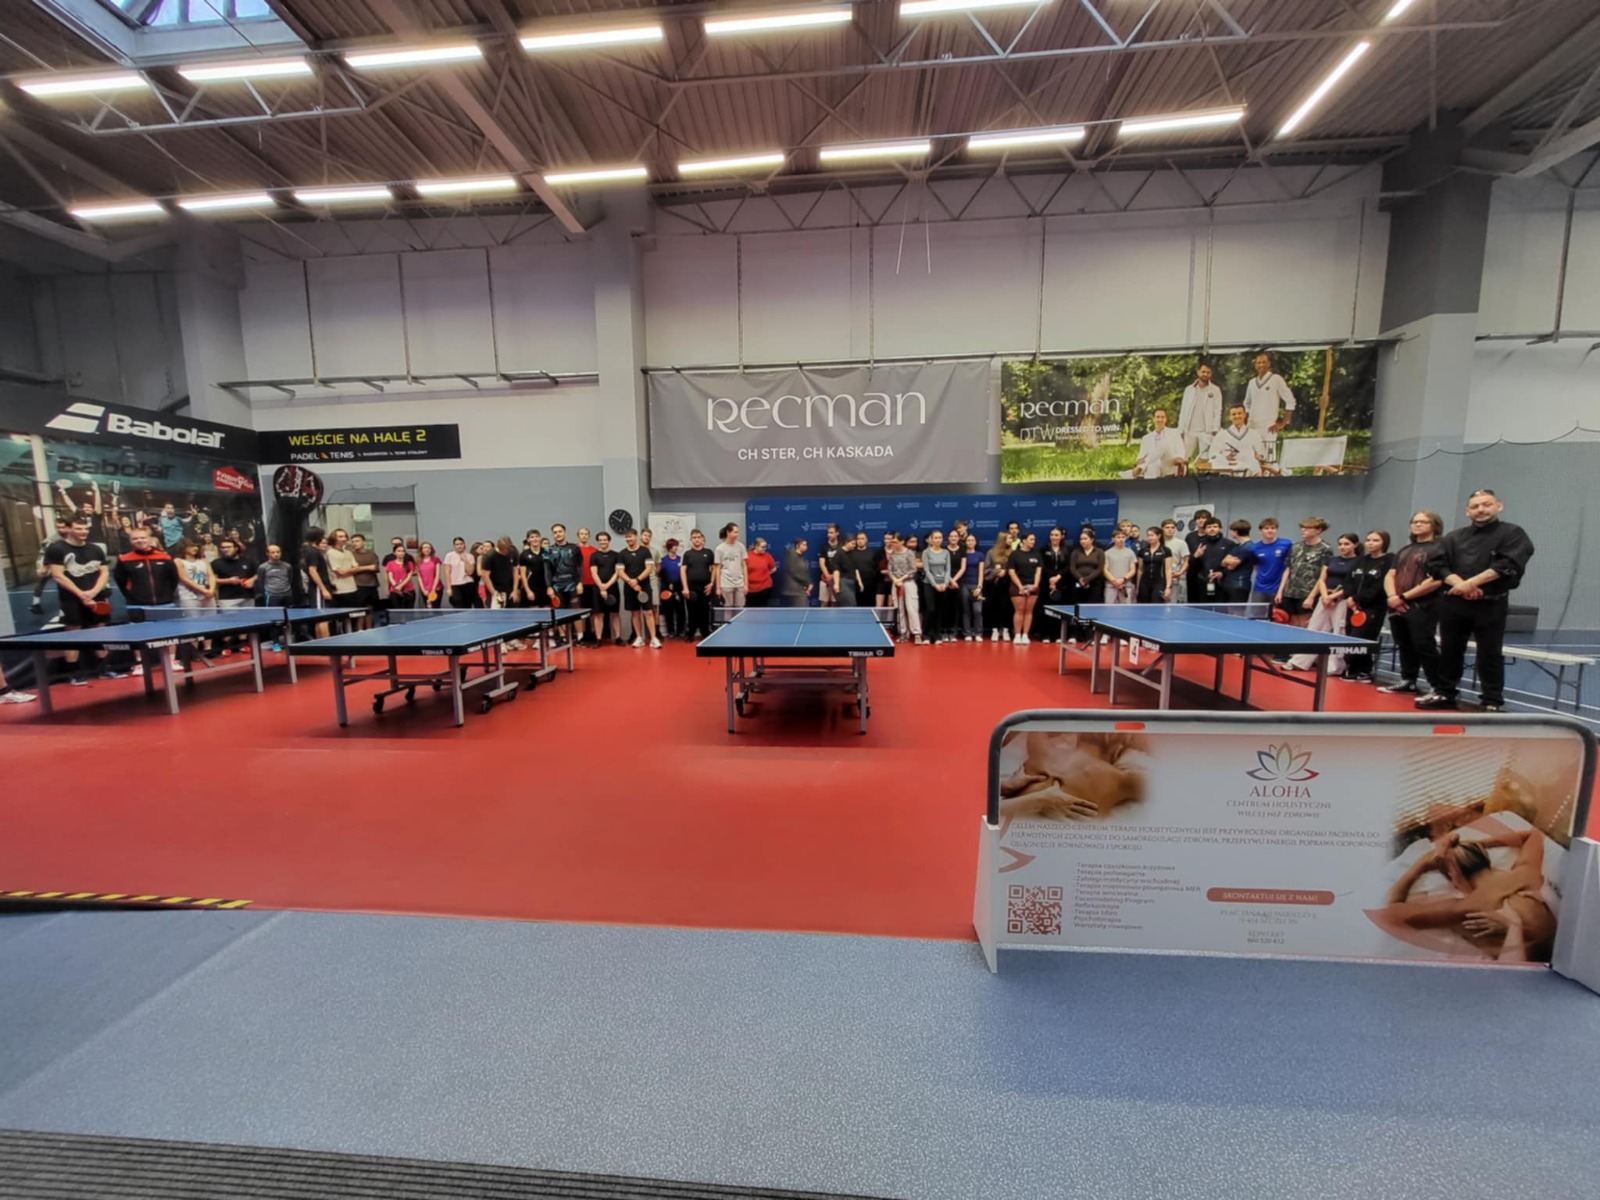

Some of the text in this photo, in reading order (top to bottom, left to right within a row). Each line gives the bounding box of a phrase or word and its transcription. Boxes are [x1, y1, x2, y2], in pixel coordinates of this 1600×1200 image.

[1056, 426, 1090, 434] DRESSED
[1103, 424, 1120, 432] WIN
[288, 429, 427, 446] WEJŚCIE NA HALĘ 2
[290, 452, 319, 460] PADEL
[330, 451, 355, 459] TENIS
[738, 445, 894, 461] CH STER, CH KASKADA
[1329, 646, 1368, 655] TIBHAR
[1249, 785, 1312, 798] ALOHA
[1226, 800, 1270, 808] CENTRUM
[1037, 823, 1070, 831] NASZEGO
[1222, 892, 1274, 900] SKONTAKTUJ
[1288, 893, 1295, 901] Z
